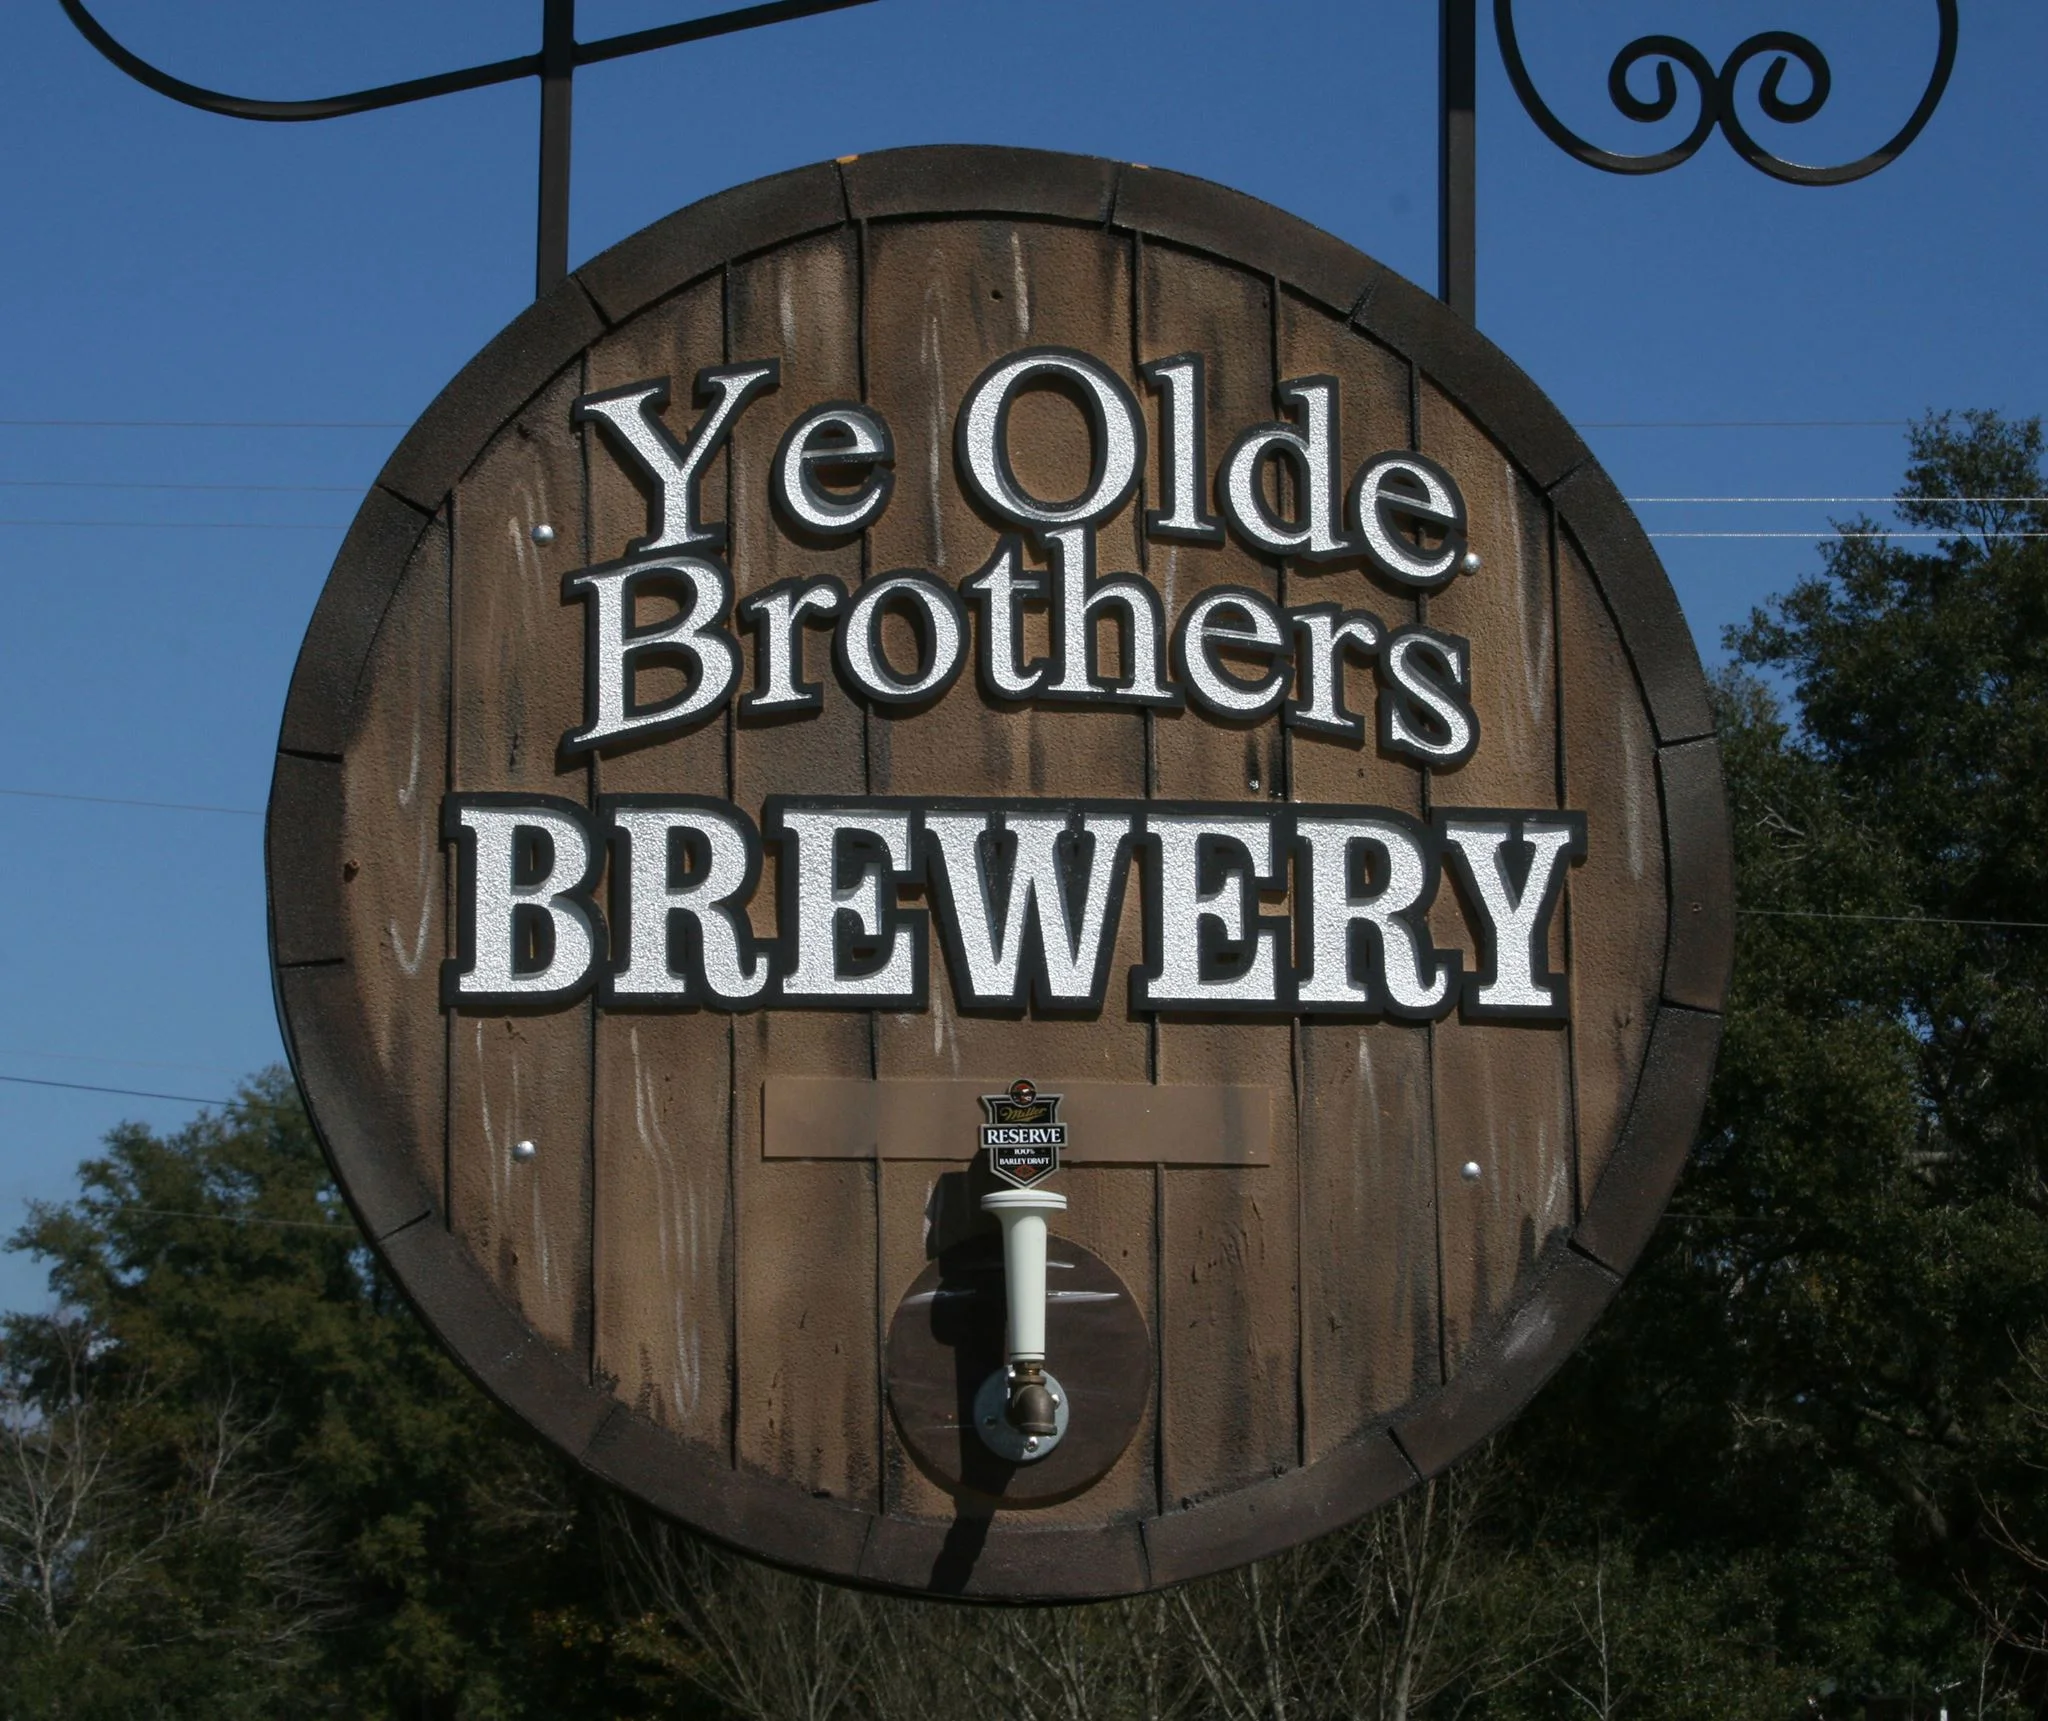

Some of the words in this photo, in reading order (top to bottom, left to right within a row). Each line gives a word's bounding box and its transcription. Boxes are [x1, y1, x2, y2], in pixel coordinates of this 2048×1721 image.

[581, 367, 888, 550] Ye
[964, 354, 1462, 580] Olde
[570, 528, 1474, 758] Brothers
[456, 806, 1573, 1008] BREWERY
[987, 1128, 1061, 1144] RESERVE
[999, 1157, 1027, 1165] BARLEY
[1027, 1157, 1050, 1165] DRAFT
[1000, 1106, 1048, 1122] Miller
